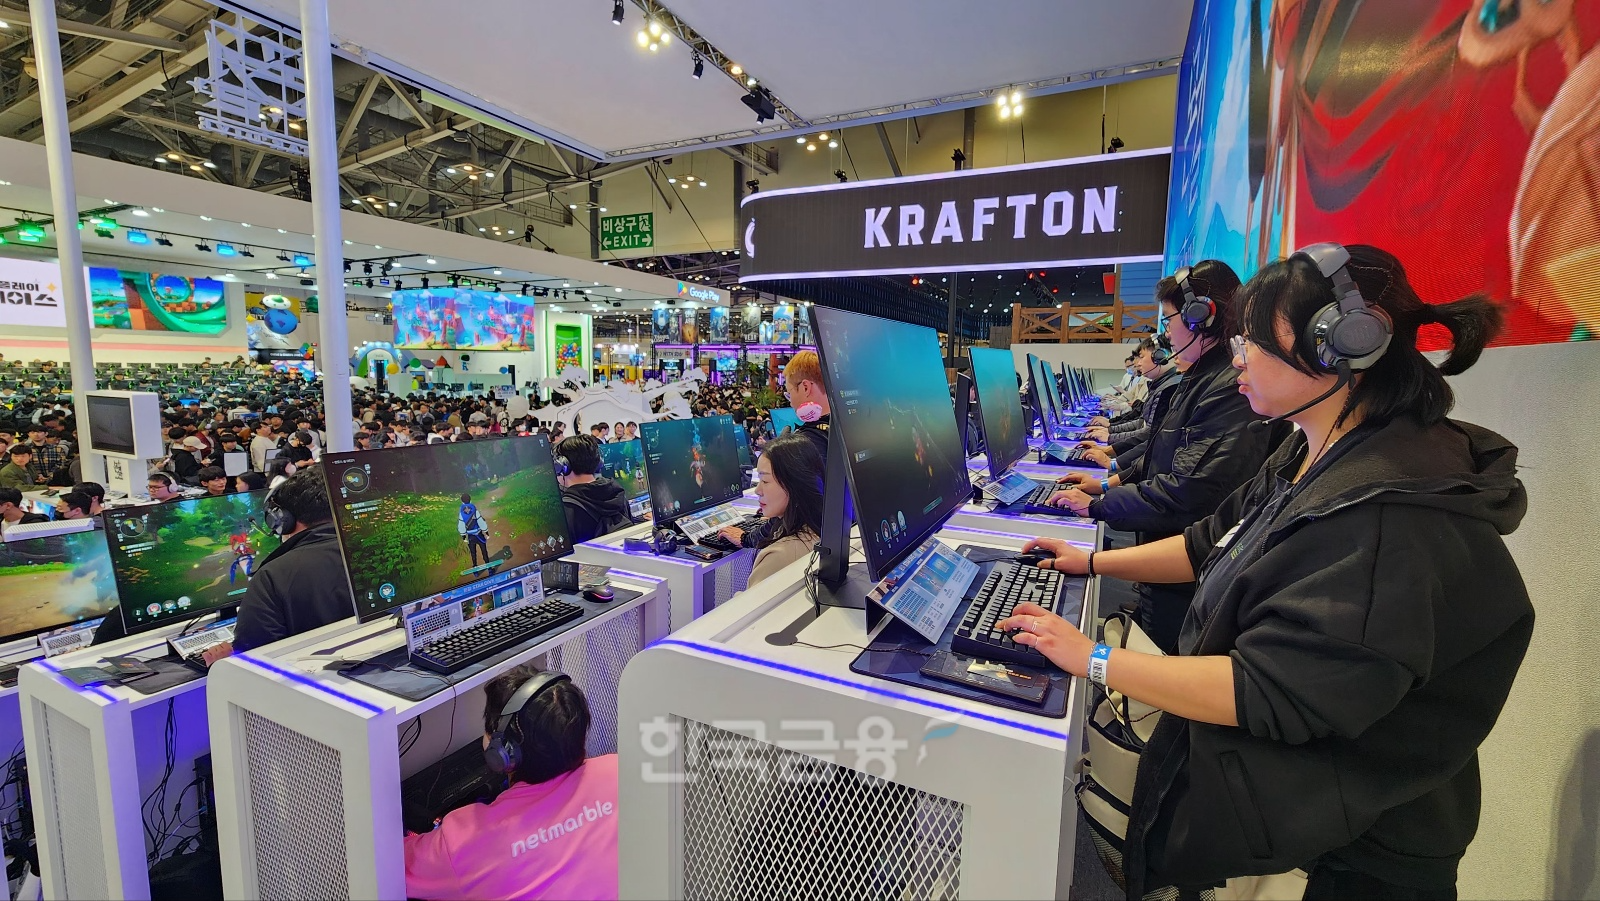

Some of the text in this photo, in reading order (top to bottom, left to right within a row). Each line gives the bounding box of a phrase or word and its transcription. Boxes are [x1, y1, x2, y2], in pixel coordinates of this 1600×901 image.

[864, 185, 1118, 248] KRAFTON
[603, 217, 637, 233] 비상구
[614, 234, 640, 247] EXIT
[0, 291, 57, 307] 이스
[690, 286, 720, 303] Google Play
[511, 800, 613, 858] netmarble
